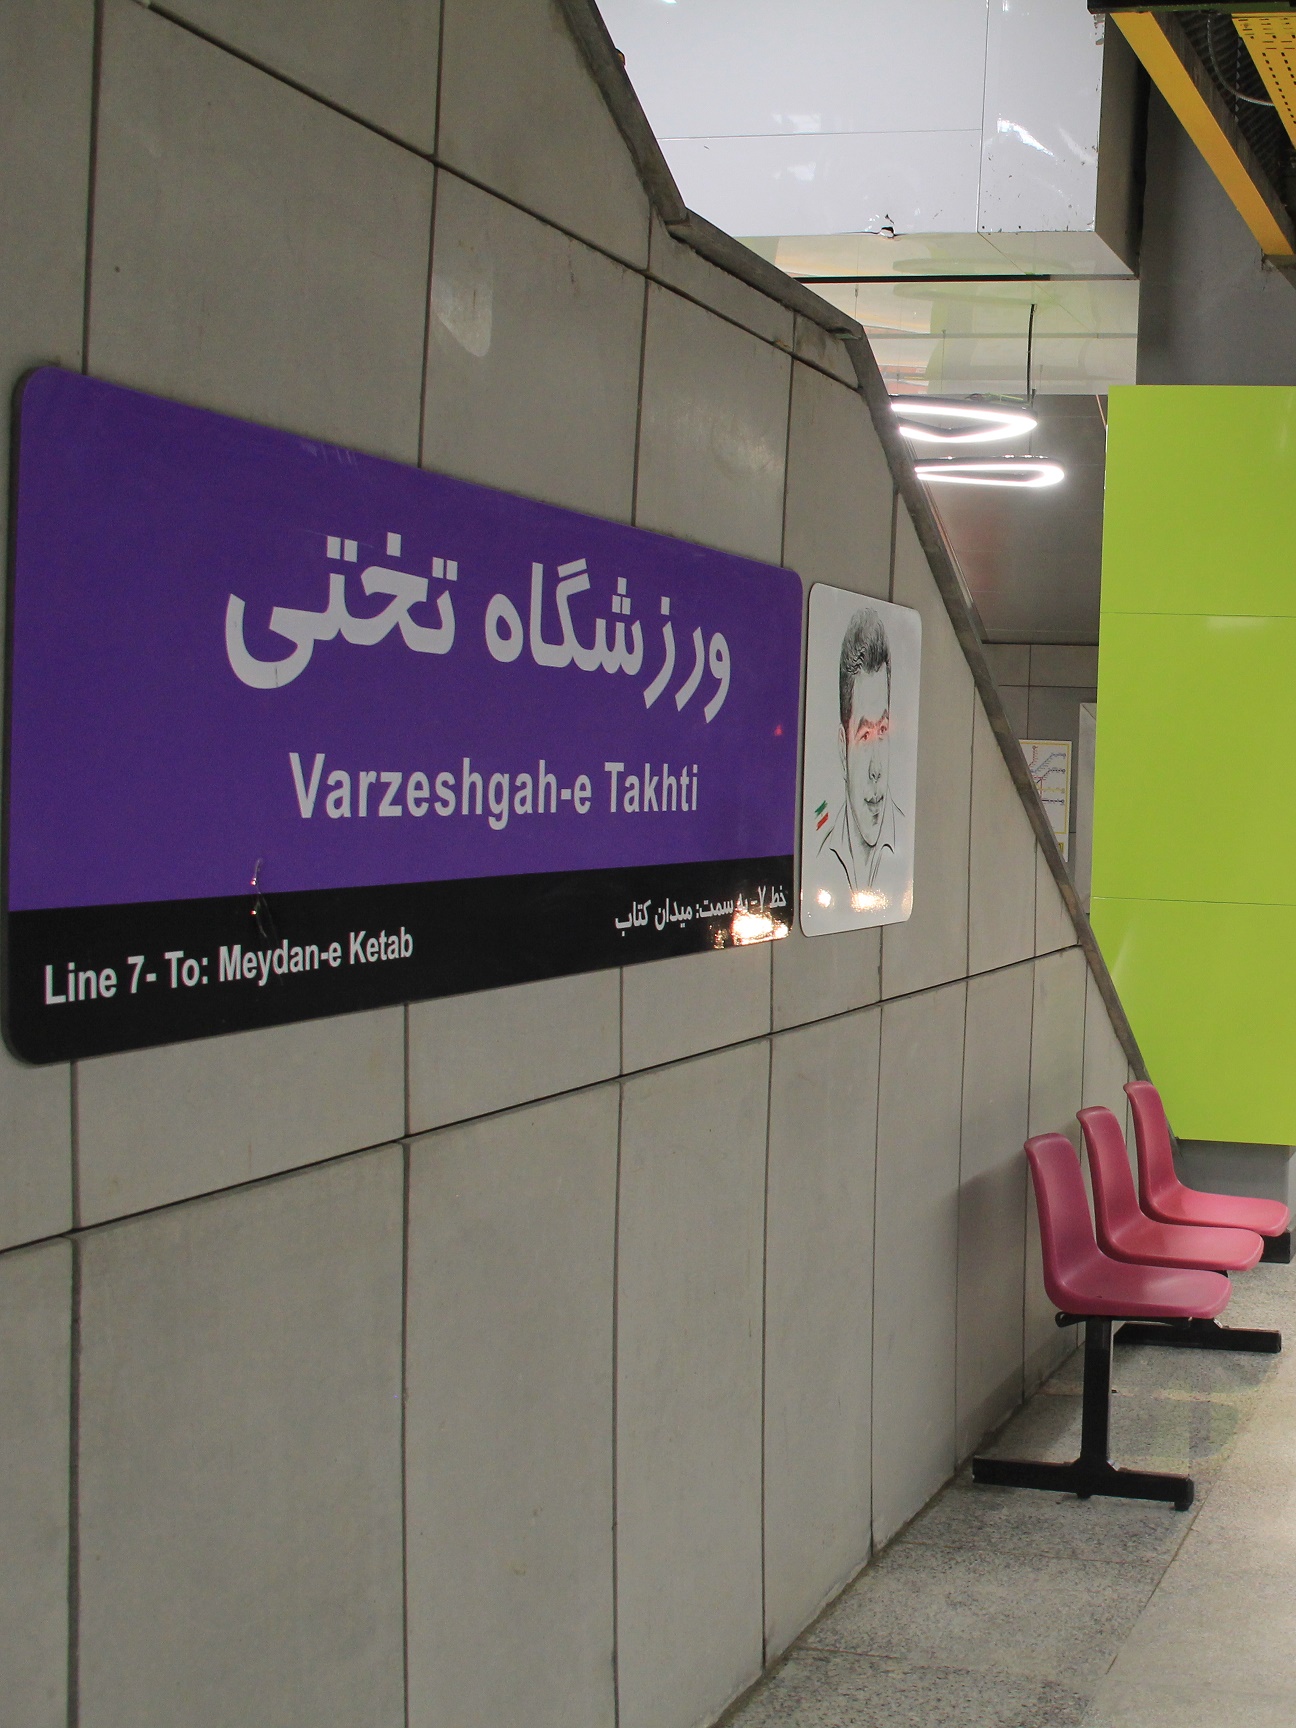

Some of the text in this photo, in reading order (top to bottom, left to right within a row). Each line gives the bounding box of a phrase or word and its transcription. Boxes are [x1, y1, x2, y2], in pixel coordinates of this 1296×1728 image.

[225, 532, 732, 724] ورزشگاه تختی
[289, 752, 699, 830] Varzeshgah-e Takhti
[655, 898, 692, 931] میدان
[696, 899, 733, 919] سمت:
[769, 885, 787, 909] خط
[614, 900, 652, 937] کتاب
[45, 926, 414, 1006] Line 7- To: Meydan-e Ketab
